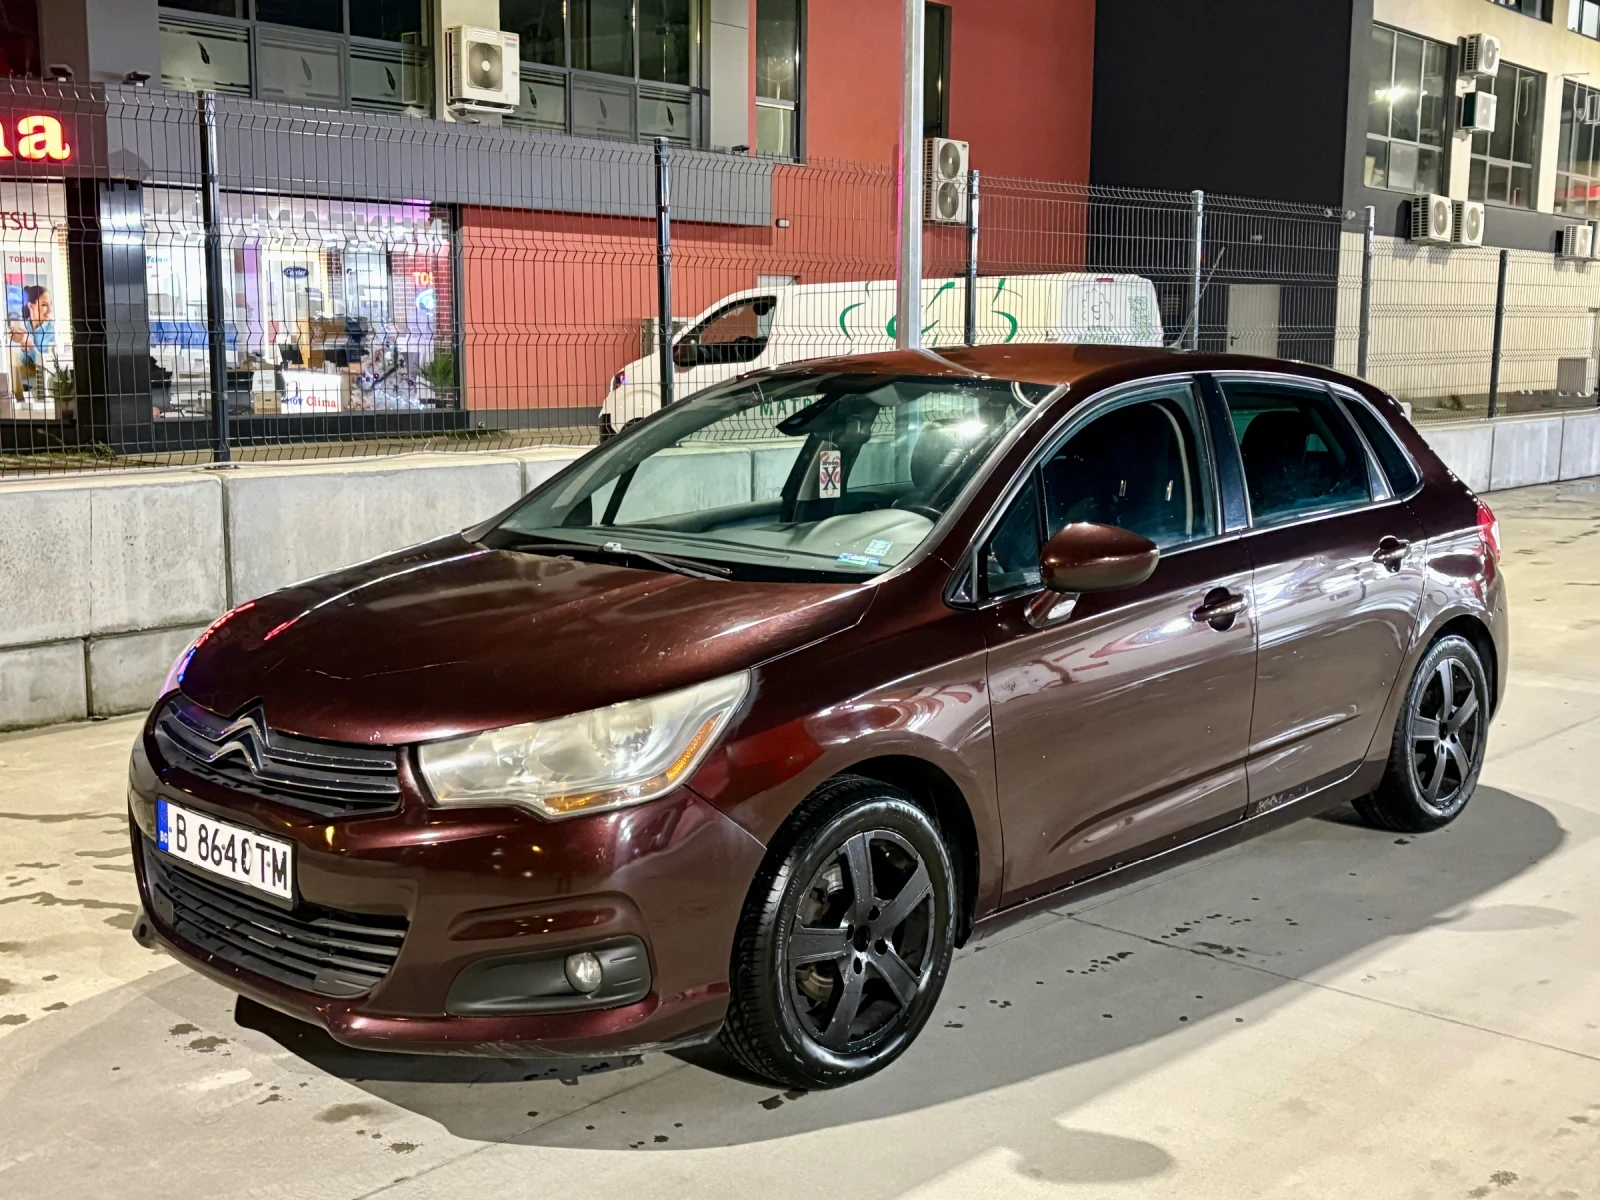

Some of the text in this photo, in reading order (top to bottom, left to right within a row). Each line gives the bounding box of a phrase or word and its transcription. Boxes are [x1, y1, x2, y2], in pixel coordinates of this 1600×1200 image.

[9, 255, 46, 264] TOSHIBA
[306, 395, 337, 408] Clima
[822, 466, 839, 491] X
[159, 830, 168, 844] BG
[176, 813, 188, 853] B
[255, 842, 288, 891] TM
